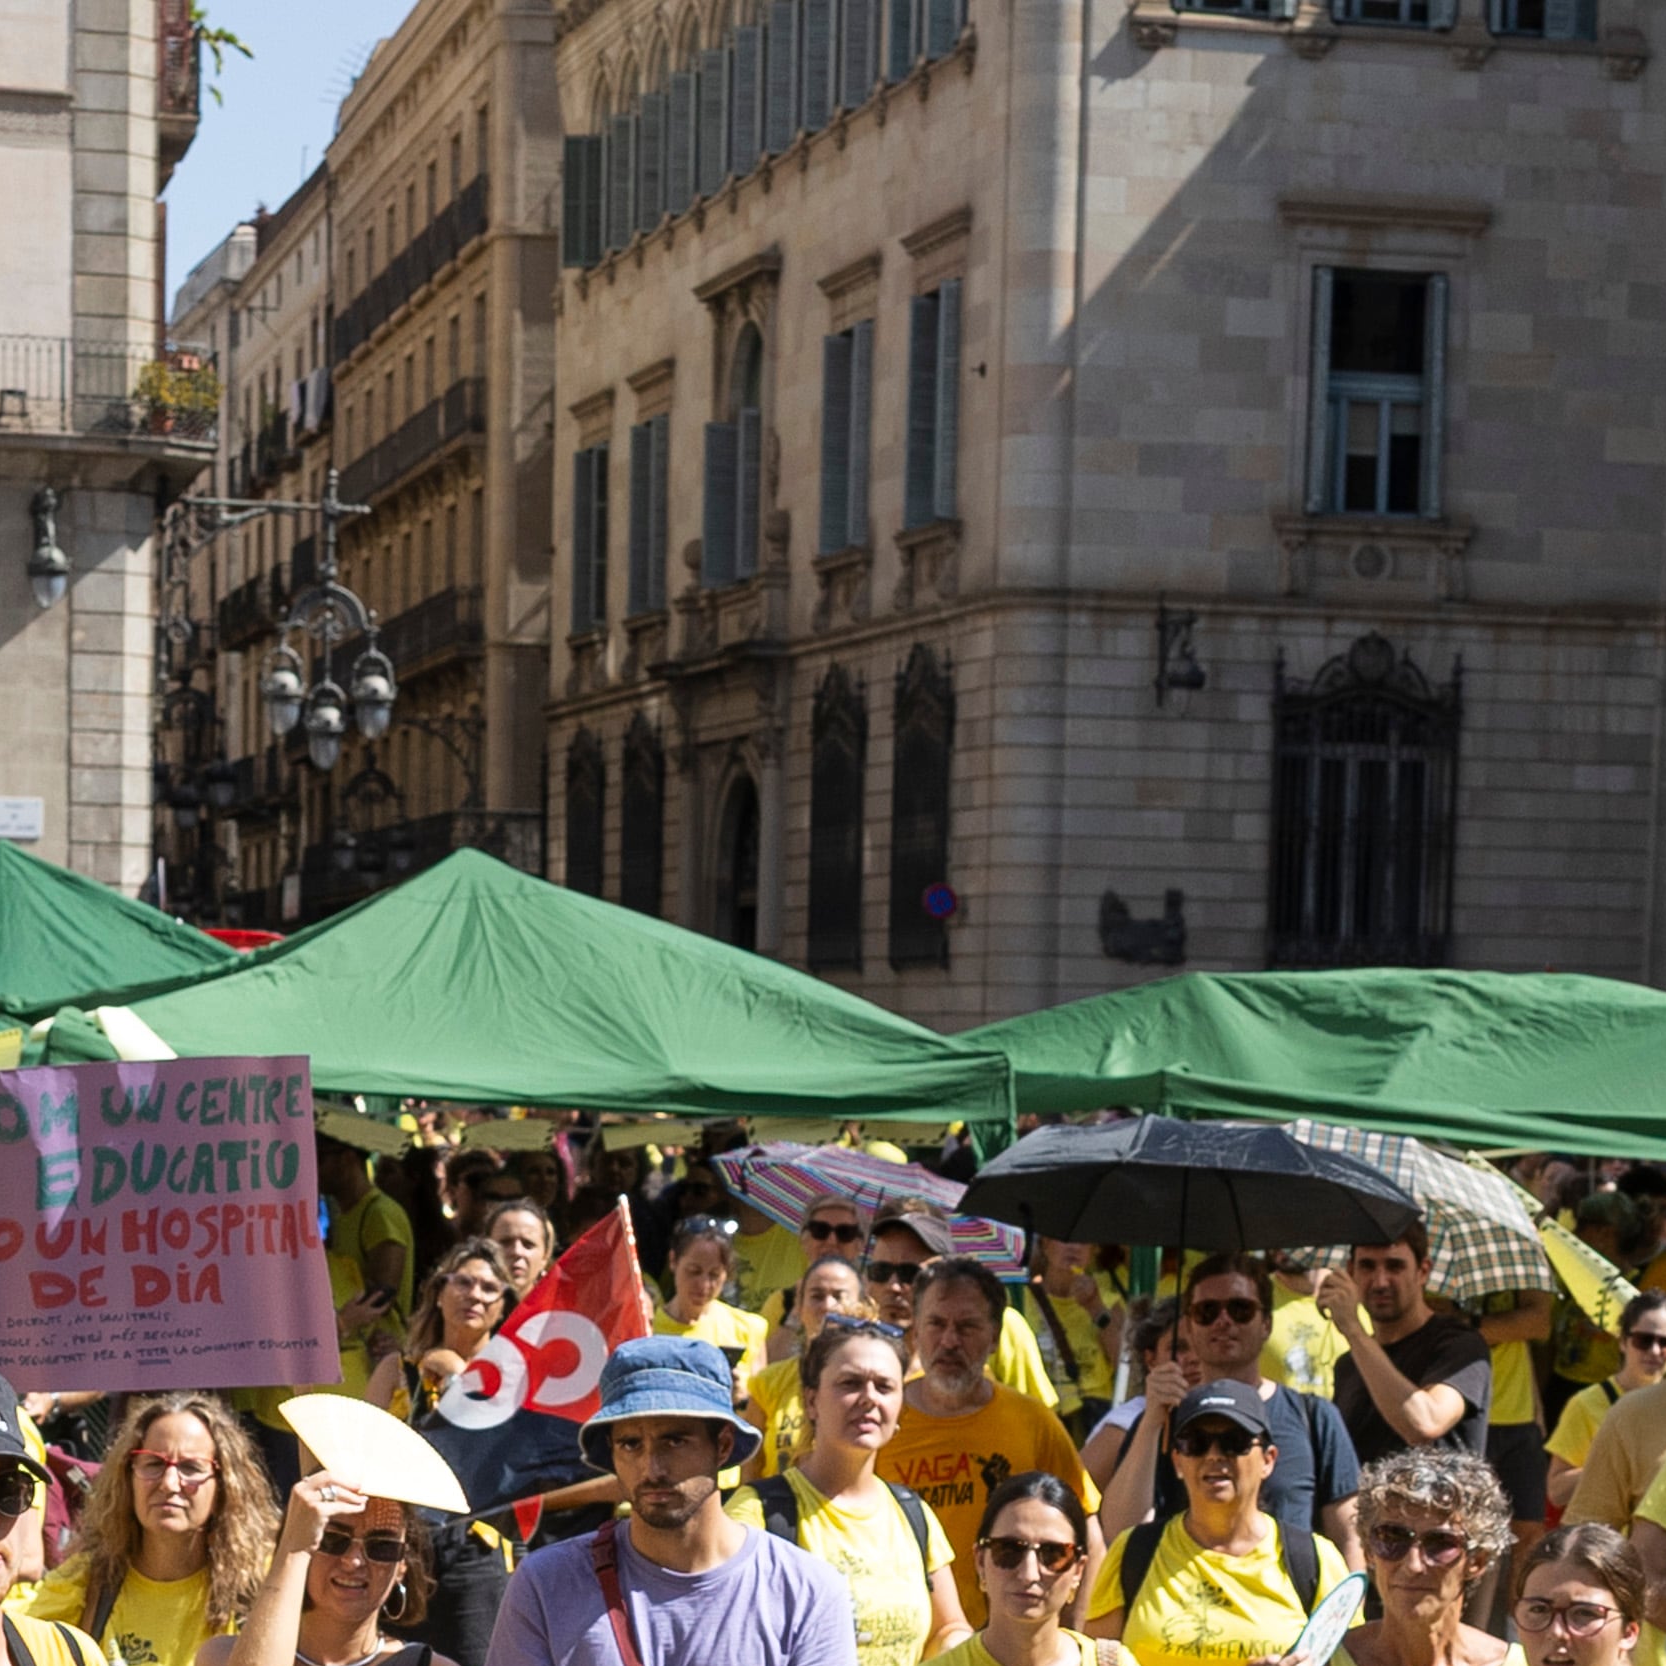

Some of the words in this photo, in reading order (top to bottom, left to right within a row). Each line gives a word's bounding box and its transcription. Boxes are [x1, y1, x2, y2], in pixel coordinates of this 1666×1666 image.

[100, 1081, 166, 1128] UN
[175, 1074, 306, 1127] CENTRE
[35, 1215, 109, 1260] UN
[28, 1265, 110, 1310] DE
[893, 1451, 972, 1486] VAGA
